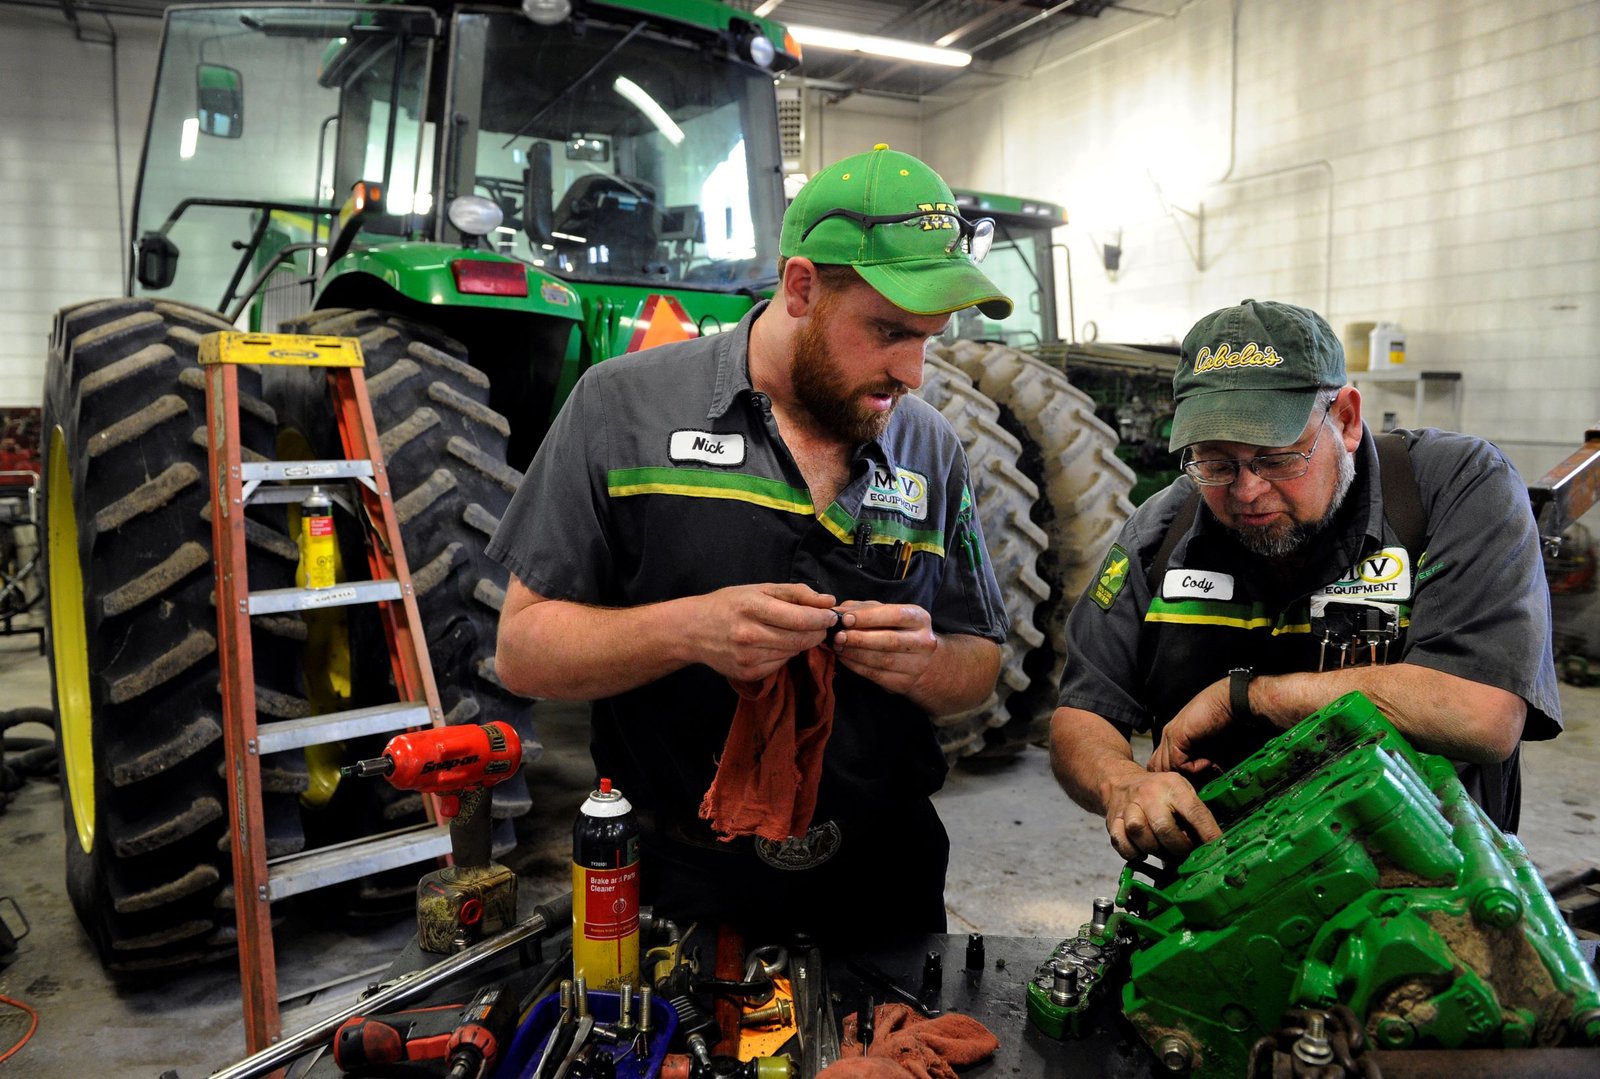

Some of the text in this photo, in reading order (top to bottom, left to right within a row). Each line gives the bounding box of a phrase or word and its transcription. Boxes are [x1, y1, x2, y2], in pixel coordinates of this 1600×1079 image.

[1193, 342, 1284, 375] Cabela's
[692, 436, 725, 454] Nick
[870, 493, 920, 513] EQUIPMENT
[1182, 575, 1214, 593] Cody
[1325, 582, 1398, 594] EQUIPMENT
[421, 755, 480, 774] Snap-on
